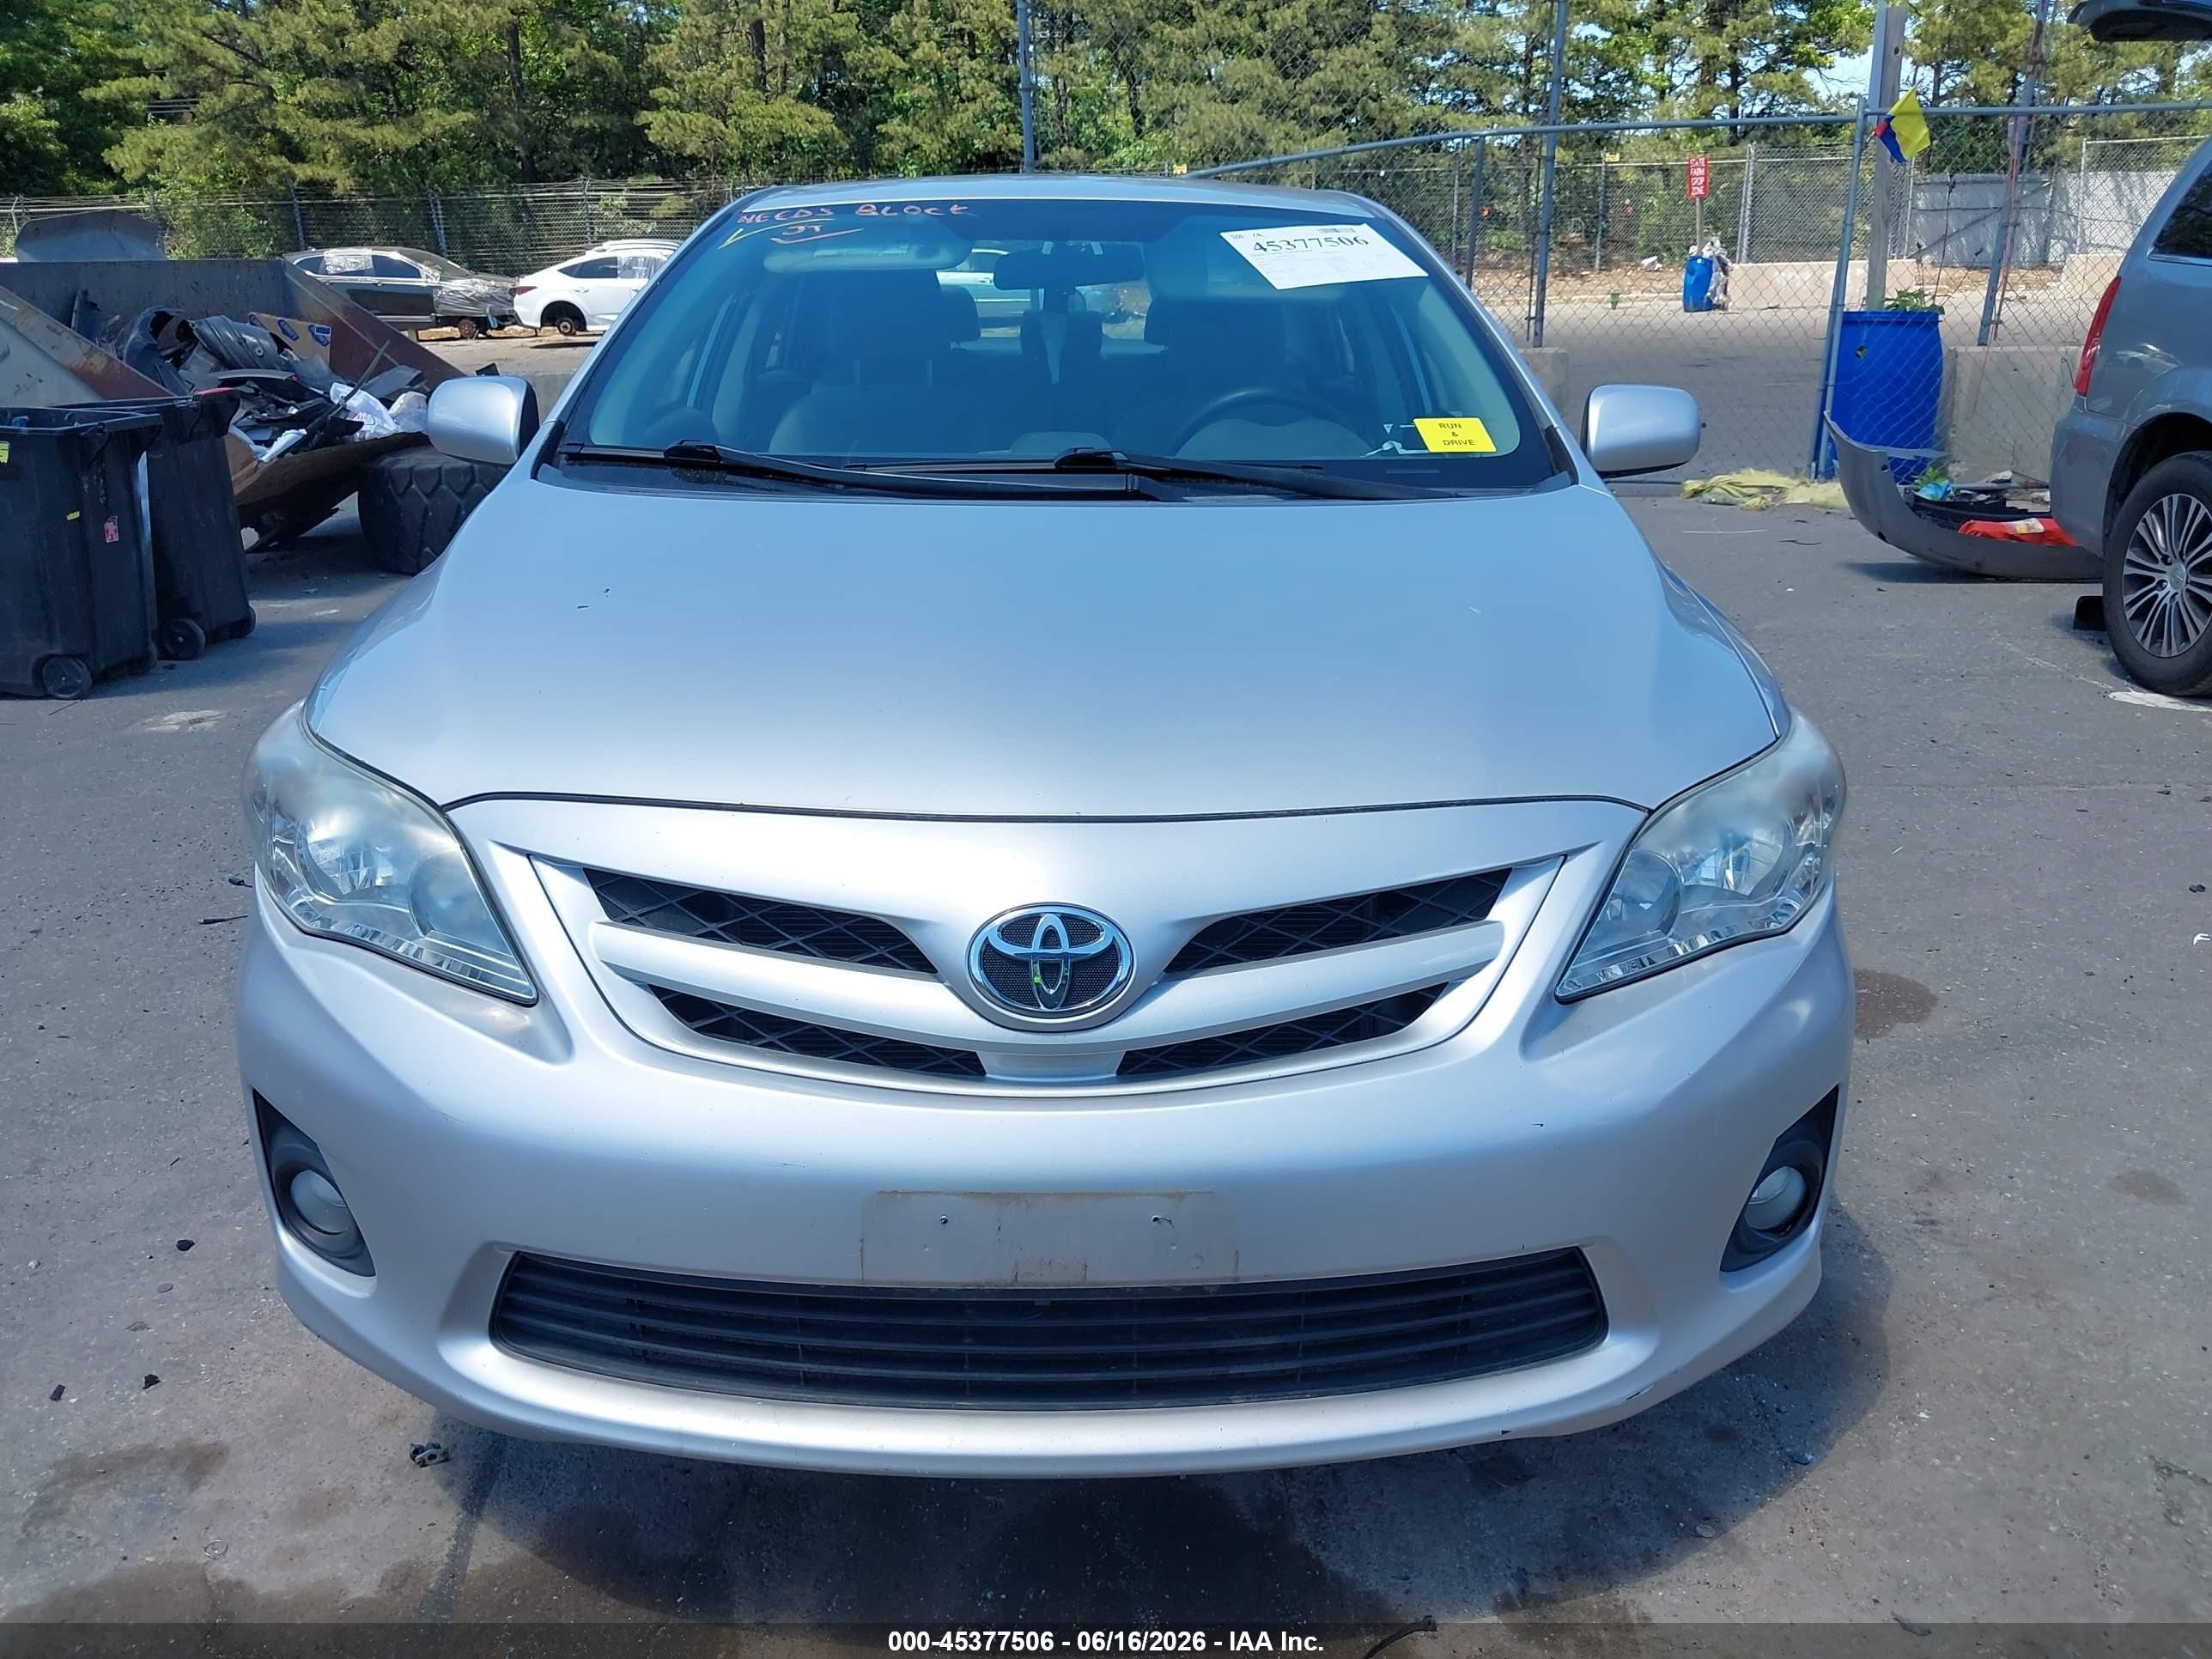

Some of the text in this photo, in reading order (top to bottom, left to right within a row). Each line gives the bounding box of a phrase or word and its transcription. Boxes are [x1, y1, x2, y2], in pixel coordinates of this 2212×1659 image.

[737, 204, 970, 224] NEEDS BLOCK
[1253, 235, 1370, 252] 45377506
